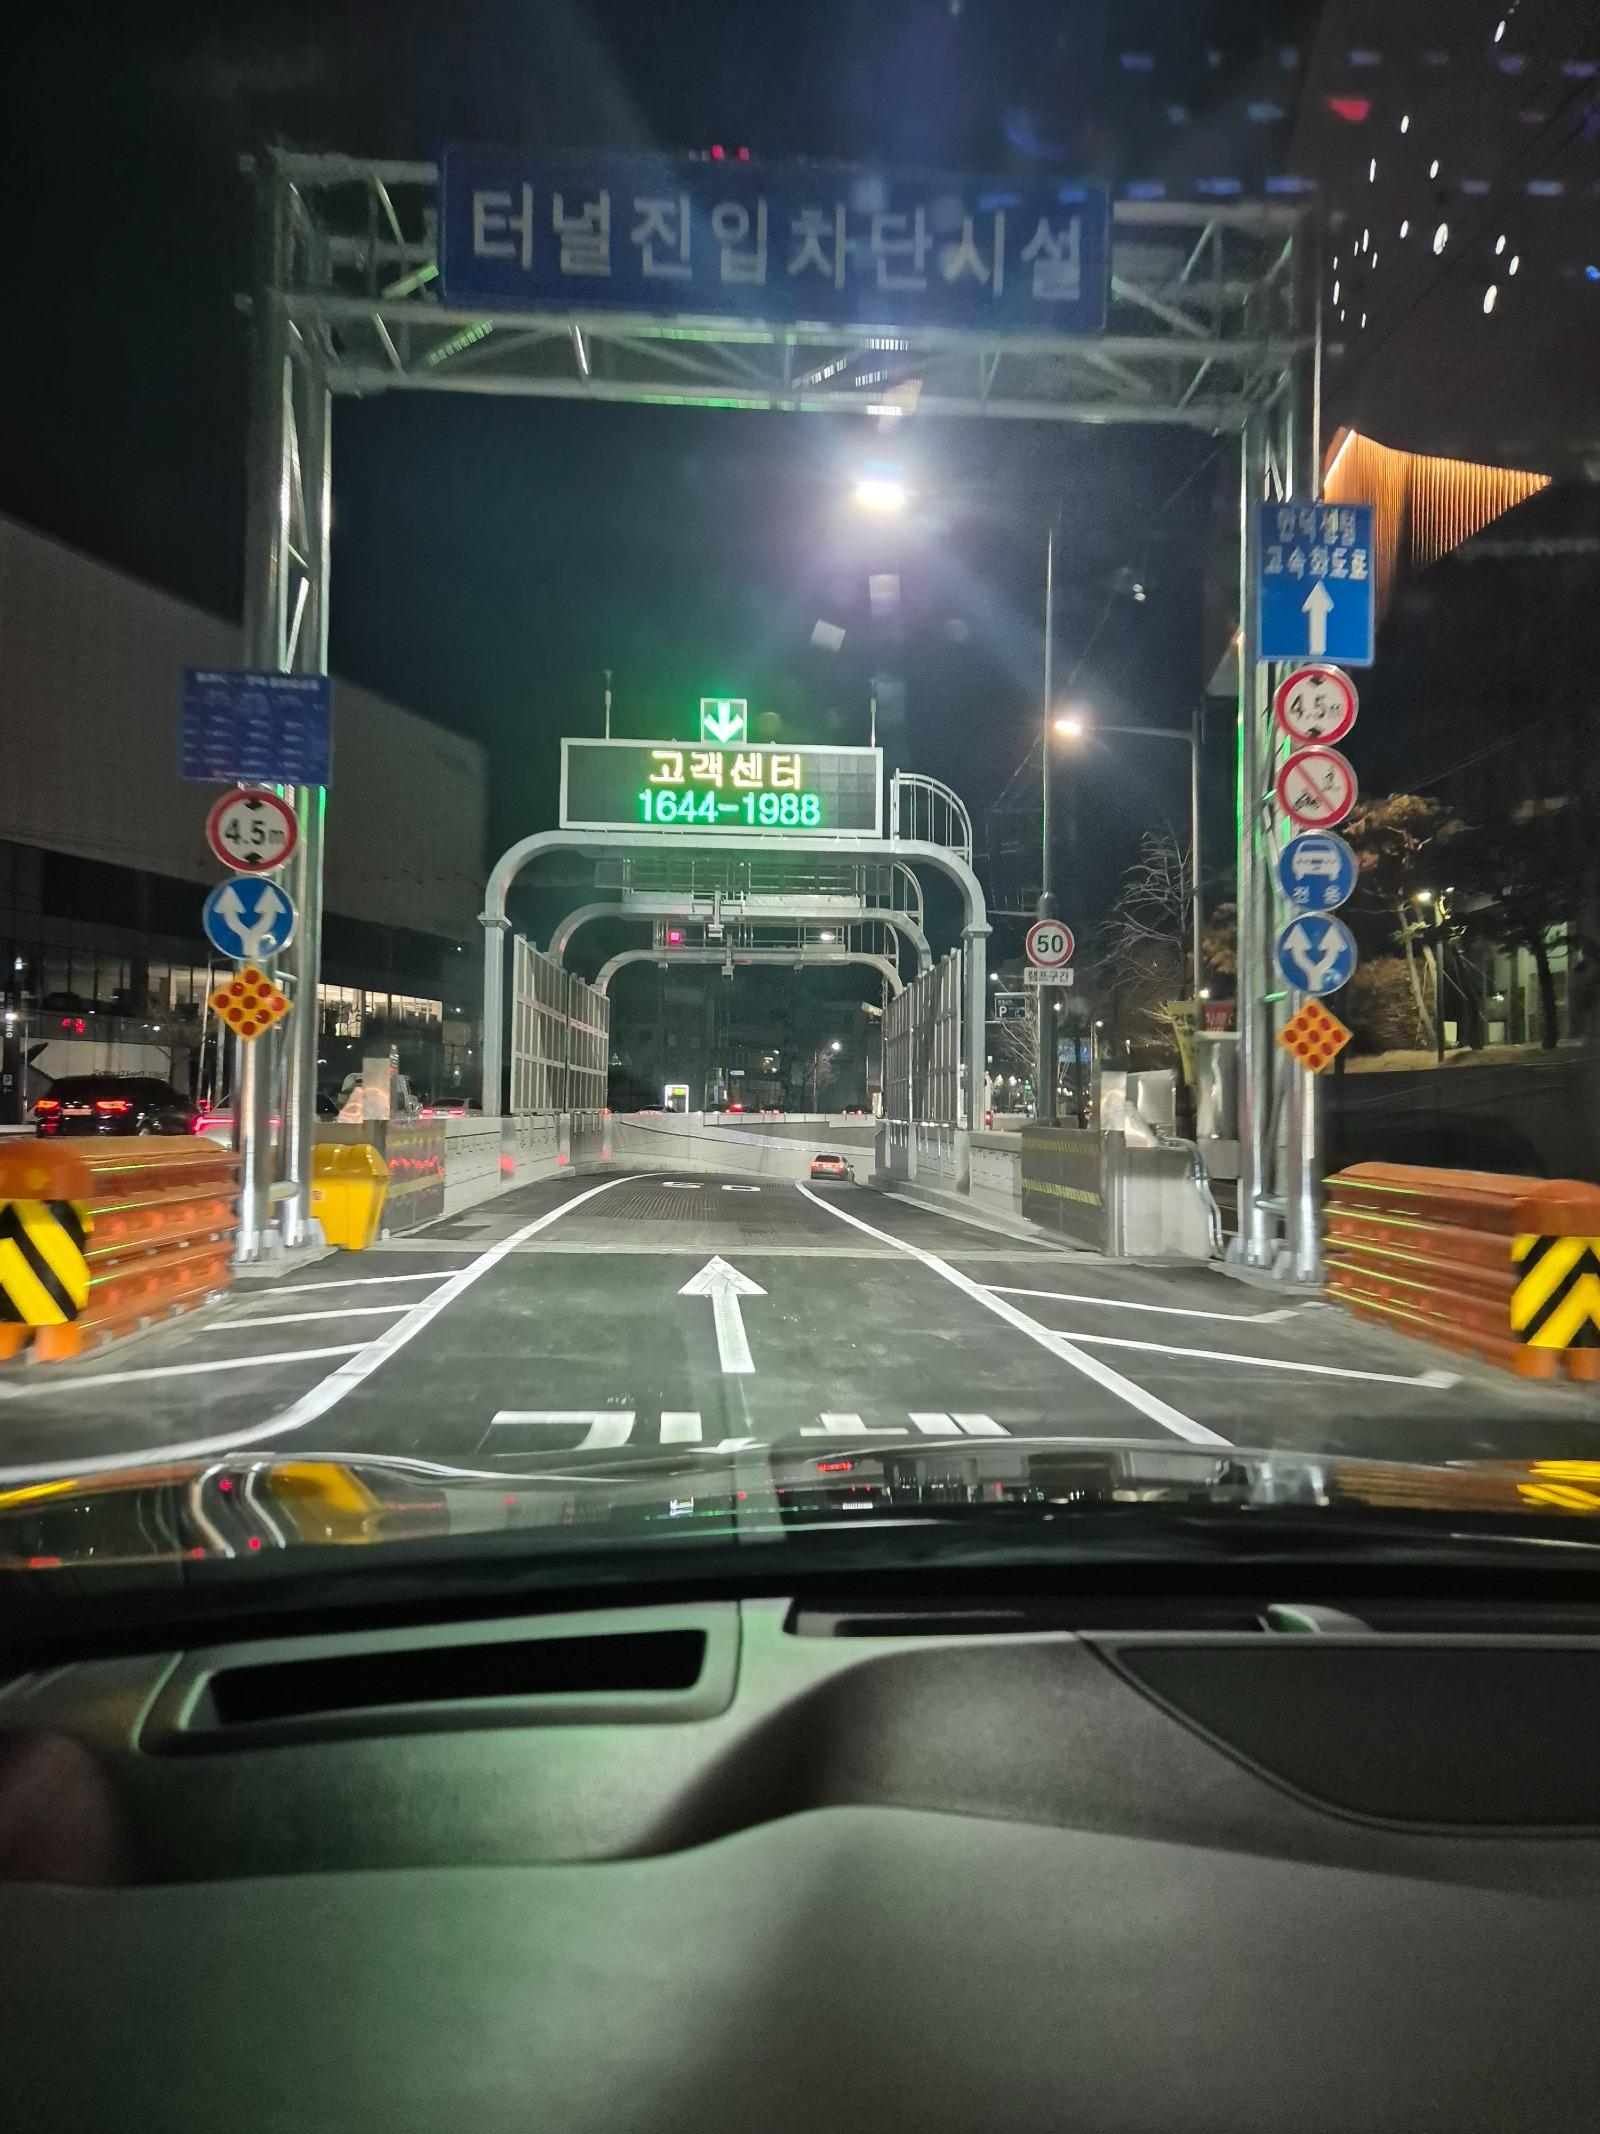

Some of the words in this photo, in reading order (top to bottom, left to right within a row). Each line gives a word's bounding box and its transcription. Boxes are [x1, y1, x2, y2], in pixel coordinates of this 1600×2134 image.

[473, 181, 1082, 302] 터널진입차단시설
[649, 750, 802, 790] 고객센터
[639, 789, 821, 826] 1644-1988
[225, 819, 285, 845] 4.5m
[1037, 935, 1064, 953] 50
[1028, 969, 1069, 983] 램프구간
